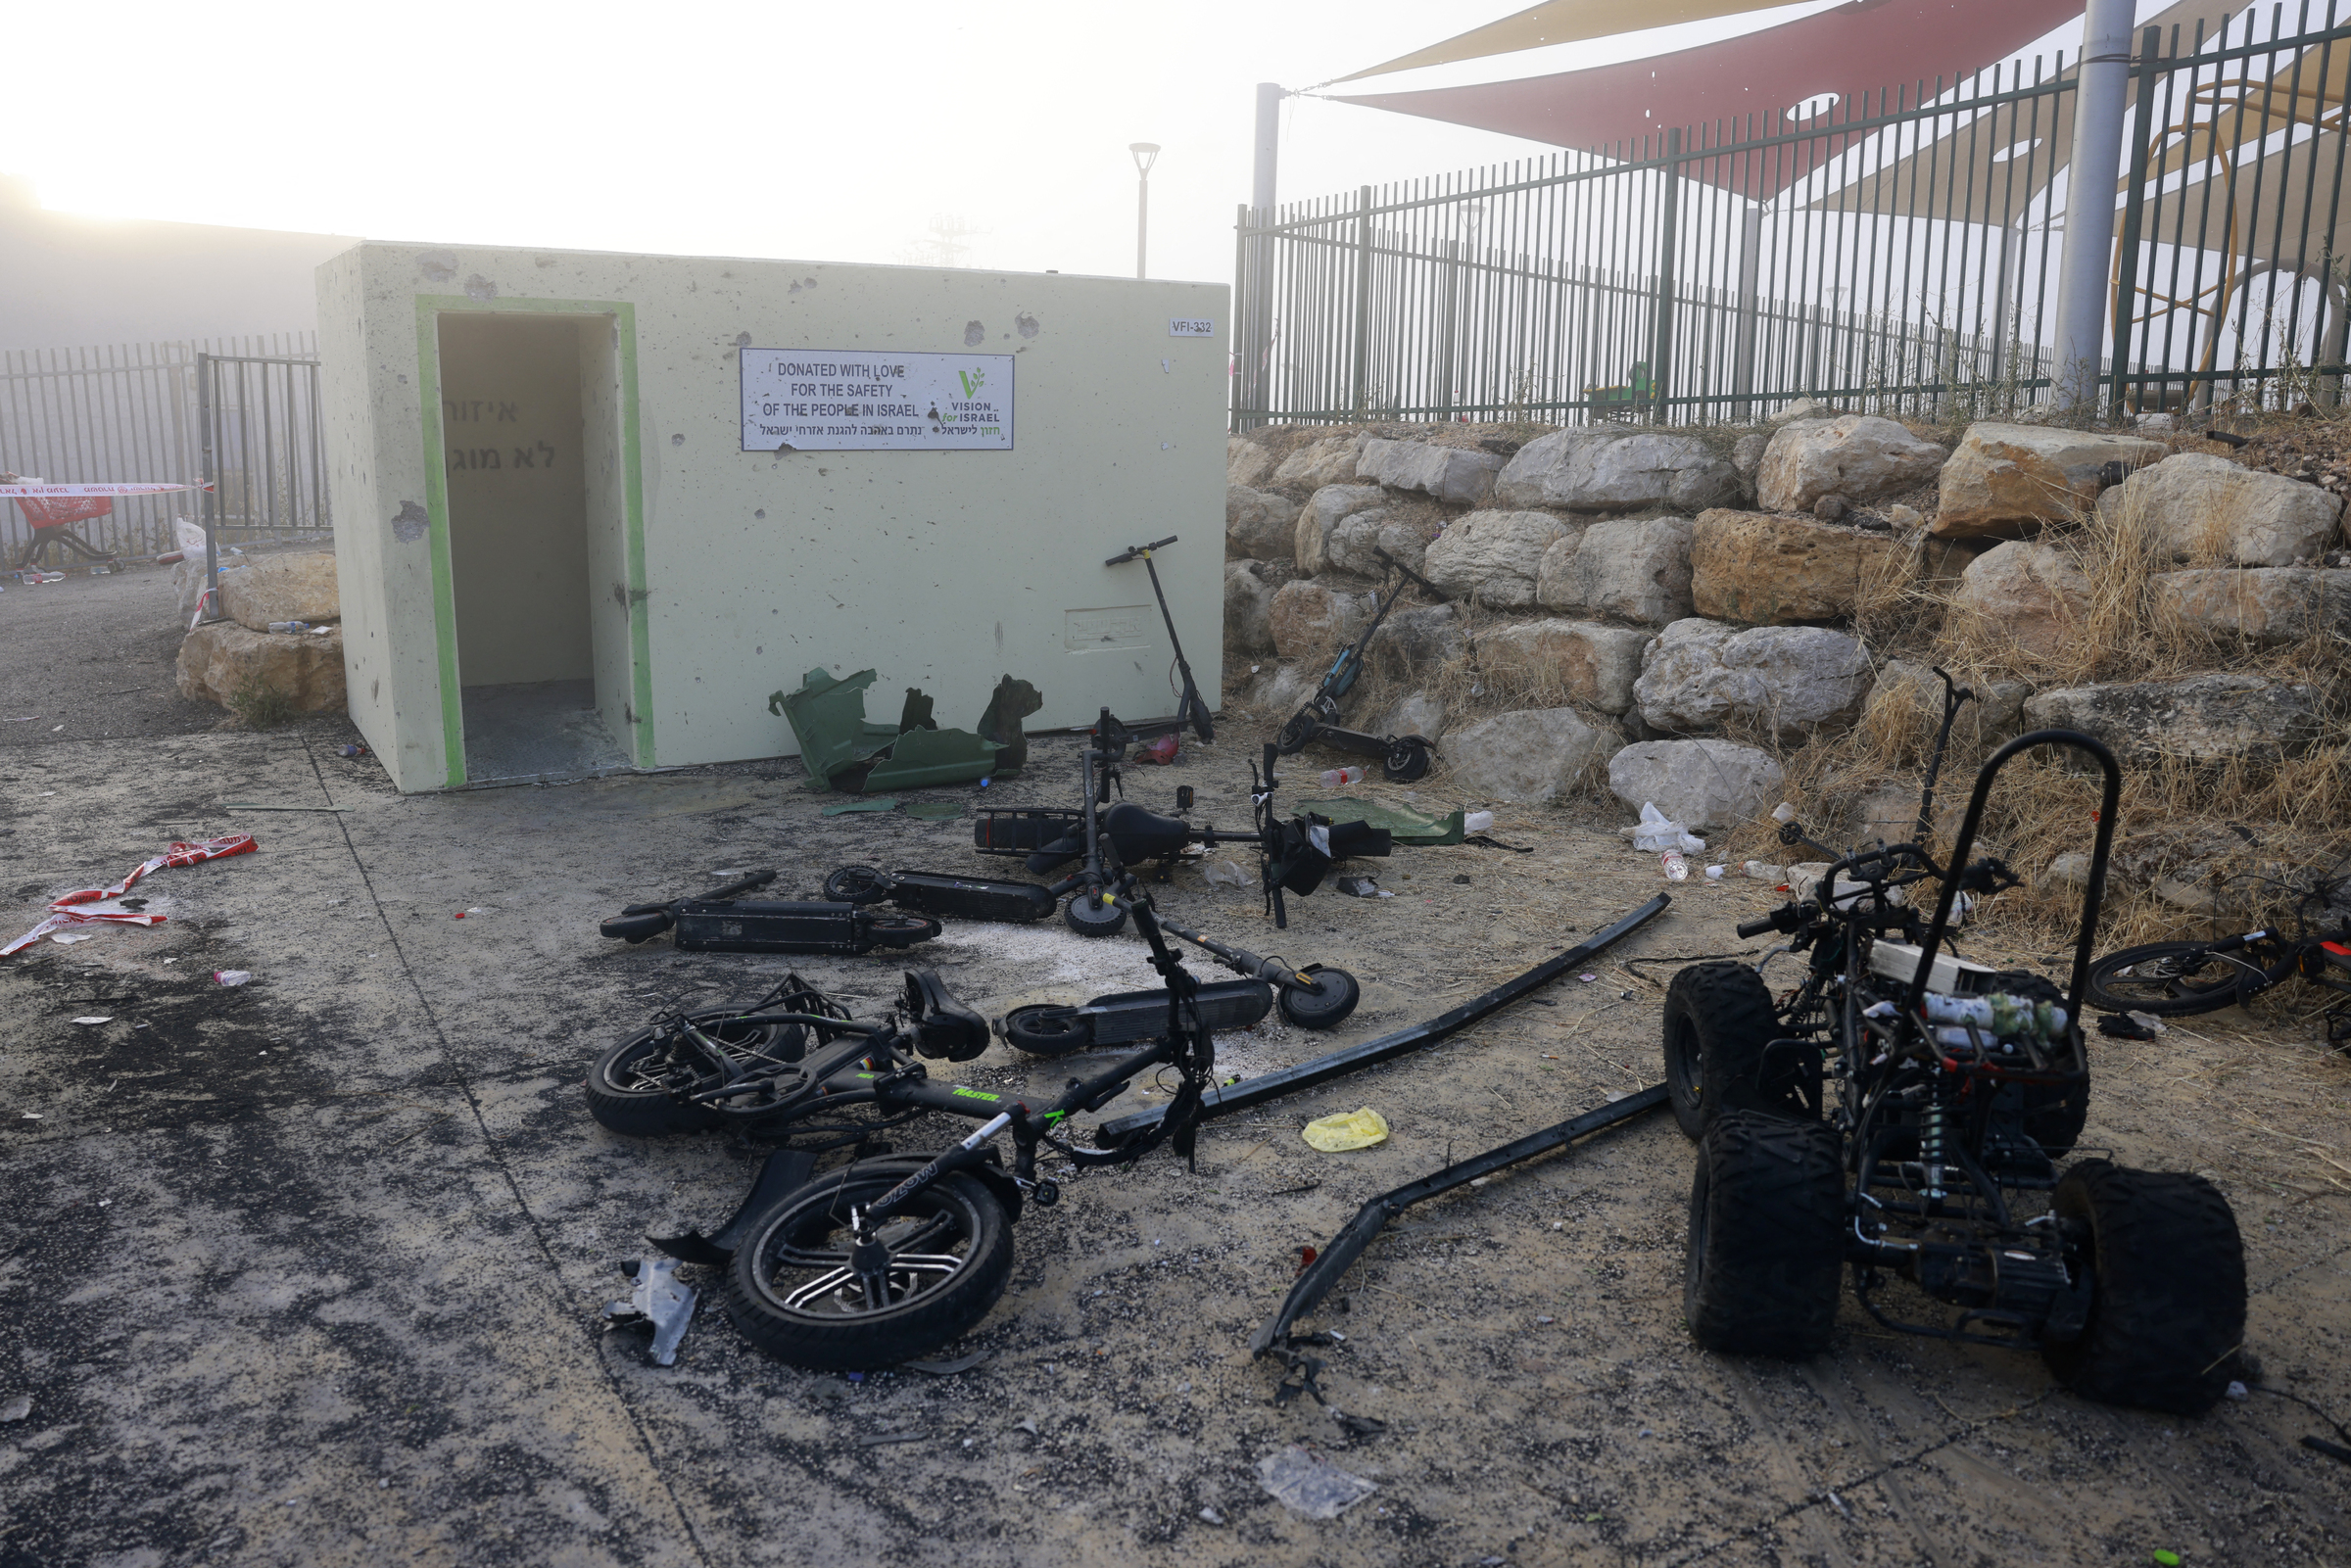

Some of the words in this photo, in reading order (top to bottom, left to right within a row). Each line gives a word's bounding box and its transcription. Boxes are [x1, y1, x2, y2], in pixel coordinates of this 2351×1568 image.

[1173, 321, 1212, 333] VFI-332
[778, 362, 837, 376] DONATED
[840, 364, 870, 377] WITH
[873, 364, 904, 378] LOVE
[791, 383, 816, 397] FOR
[820, 384, 843, 397] THE
[846, 384, 893, 398] SAFETY
[763, 403, 780, 416] OF
[783, 404, 807, 416] THE
[811, 404, 859, 417] PEOPLE
[862, 404, 874, 417] IN
[877, 404, 919, 417] ISRAEL
[951, 402, 991, 411] VISION
[941, 412, 958, 422] for
[959, 413, 1000, 422] ISRAEL
[759, 423, 792, 436] ישראל
[795, 425, 825, 436] אזרחי
[827, 423, 857, 436] להגנת
[860, 425, 894, 436] באהבה
[896, 425, 922, 436] נתרם
[941, 424, 978, 435] לישראל
[981, 426, 1000, 438] חזון
[447, 449, 501, 471] מוג
[514, 441, 554, 469] לא
[952, 1087, 1000, 1102] MASTER
